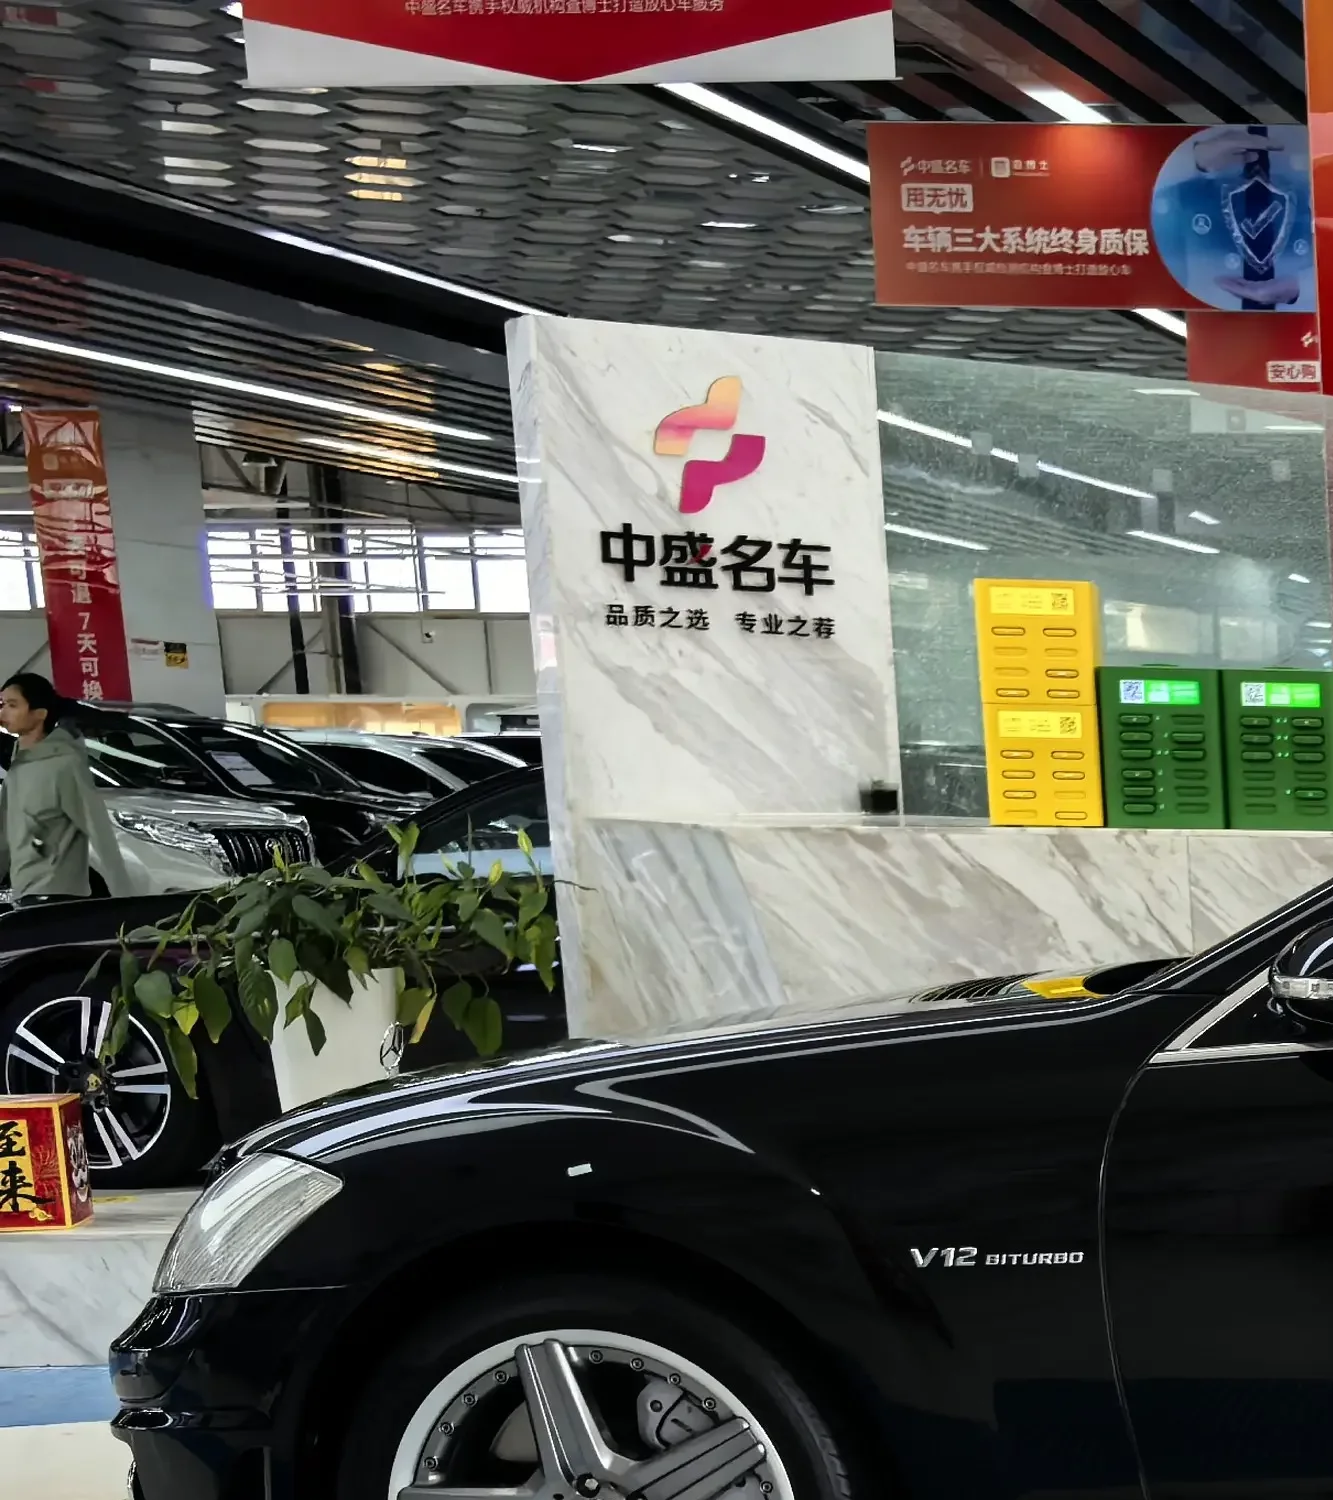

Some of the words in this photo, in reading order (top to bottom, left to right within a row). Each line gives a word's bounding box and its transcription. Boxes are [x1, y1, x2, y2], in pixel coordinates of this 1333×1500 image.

[906, 187, 968, 208] 用无忧
[902, 225, 1149, 256] 车辆三大系统终身质保
[1269, 364, 1317, 380] 安心购
[600, 522, 835, 596] 中盛名车
[605, 603, 710, 631] 品质之选
[735, 611, 836, 640] 专业之荐
[910, 1247, 978, 1268] V12
[985, 1251, 1085, 1266] BITURBO
